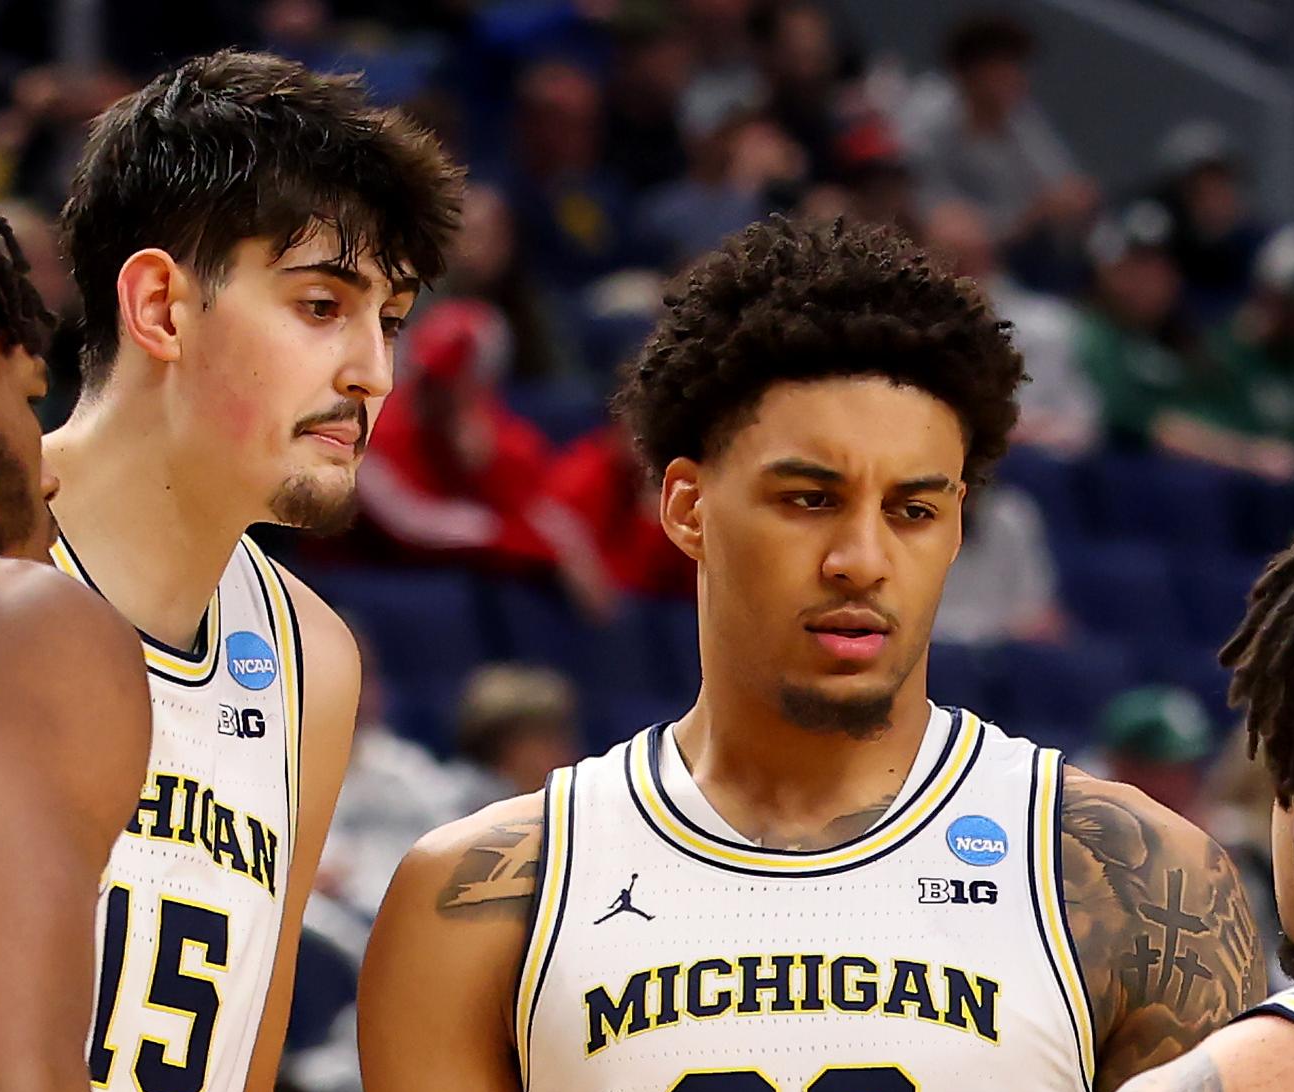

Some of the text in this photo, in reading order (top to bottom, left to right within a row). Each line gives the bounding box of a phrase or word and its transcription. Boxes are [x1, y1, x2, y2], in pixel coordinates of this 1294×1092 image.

[233, 658, 275, 675] NCAA
[955, 836, 1005, 854] NCAA
[582, 952, 1002, 1061] MICHIGAN
